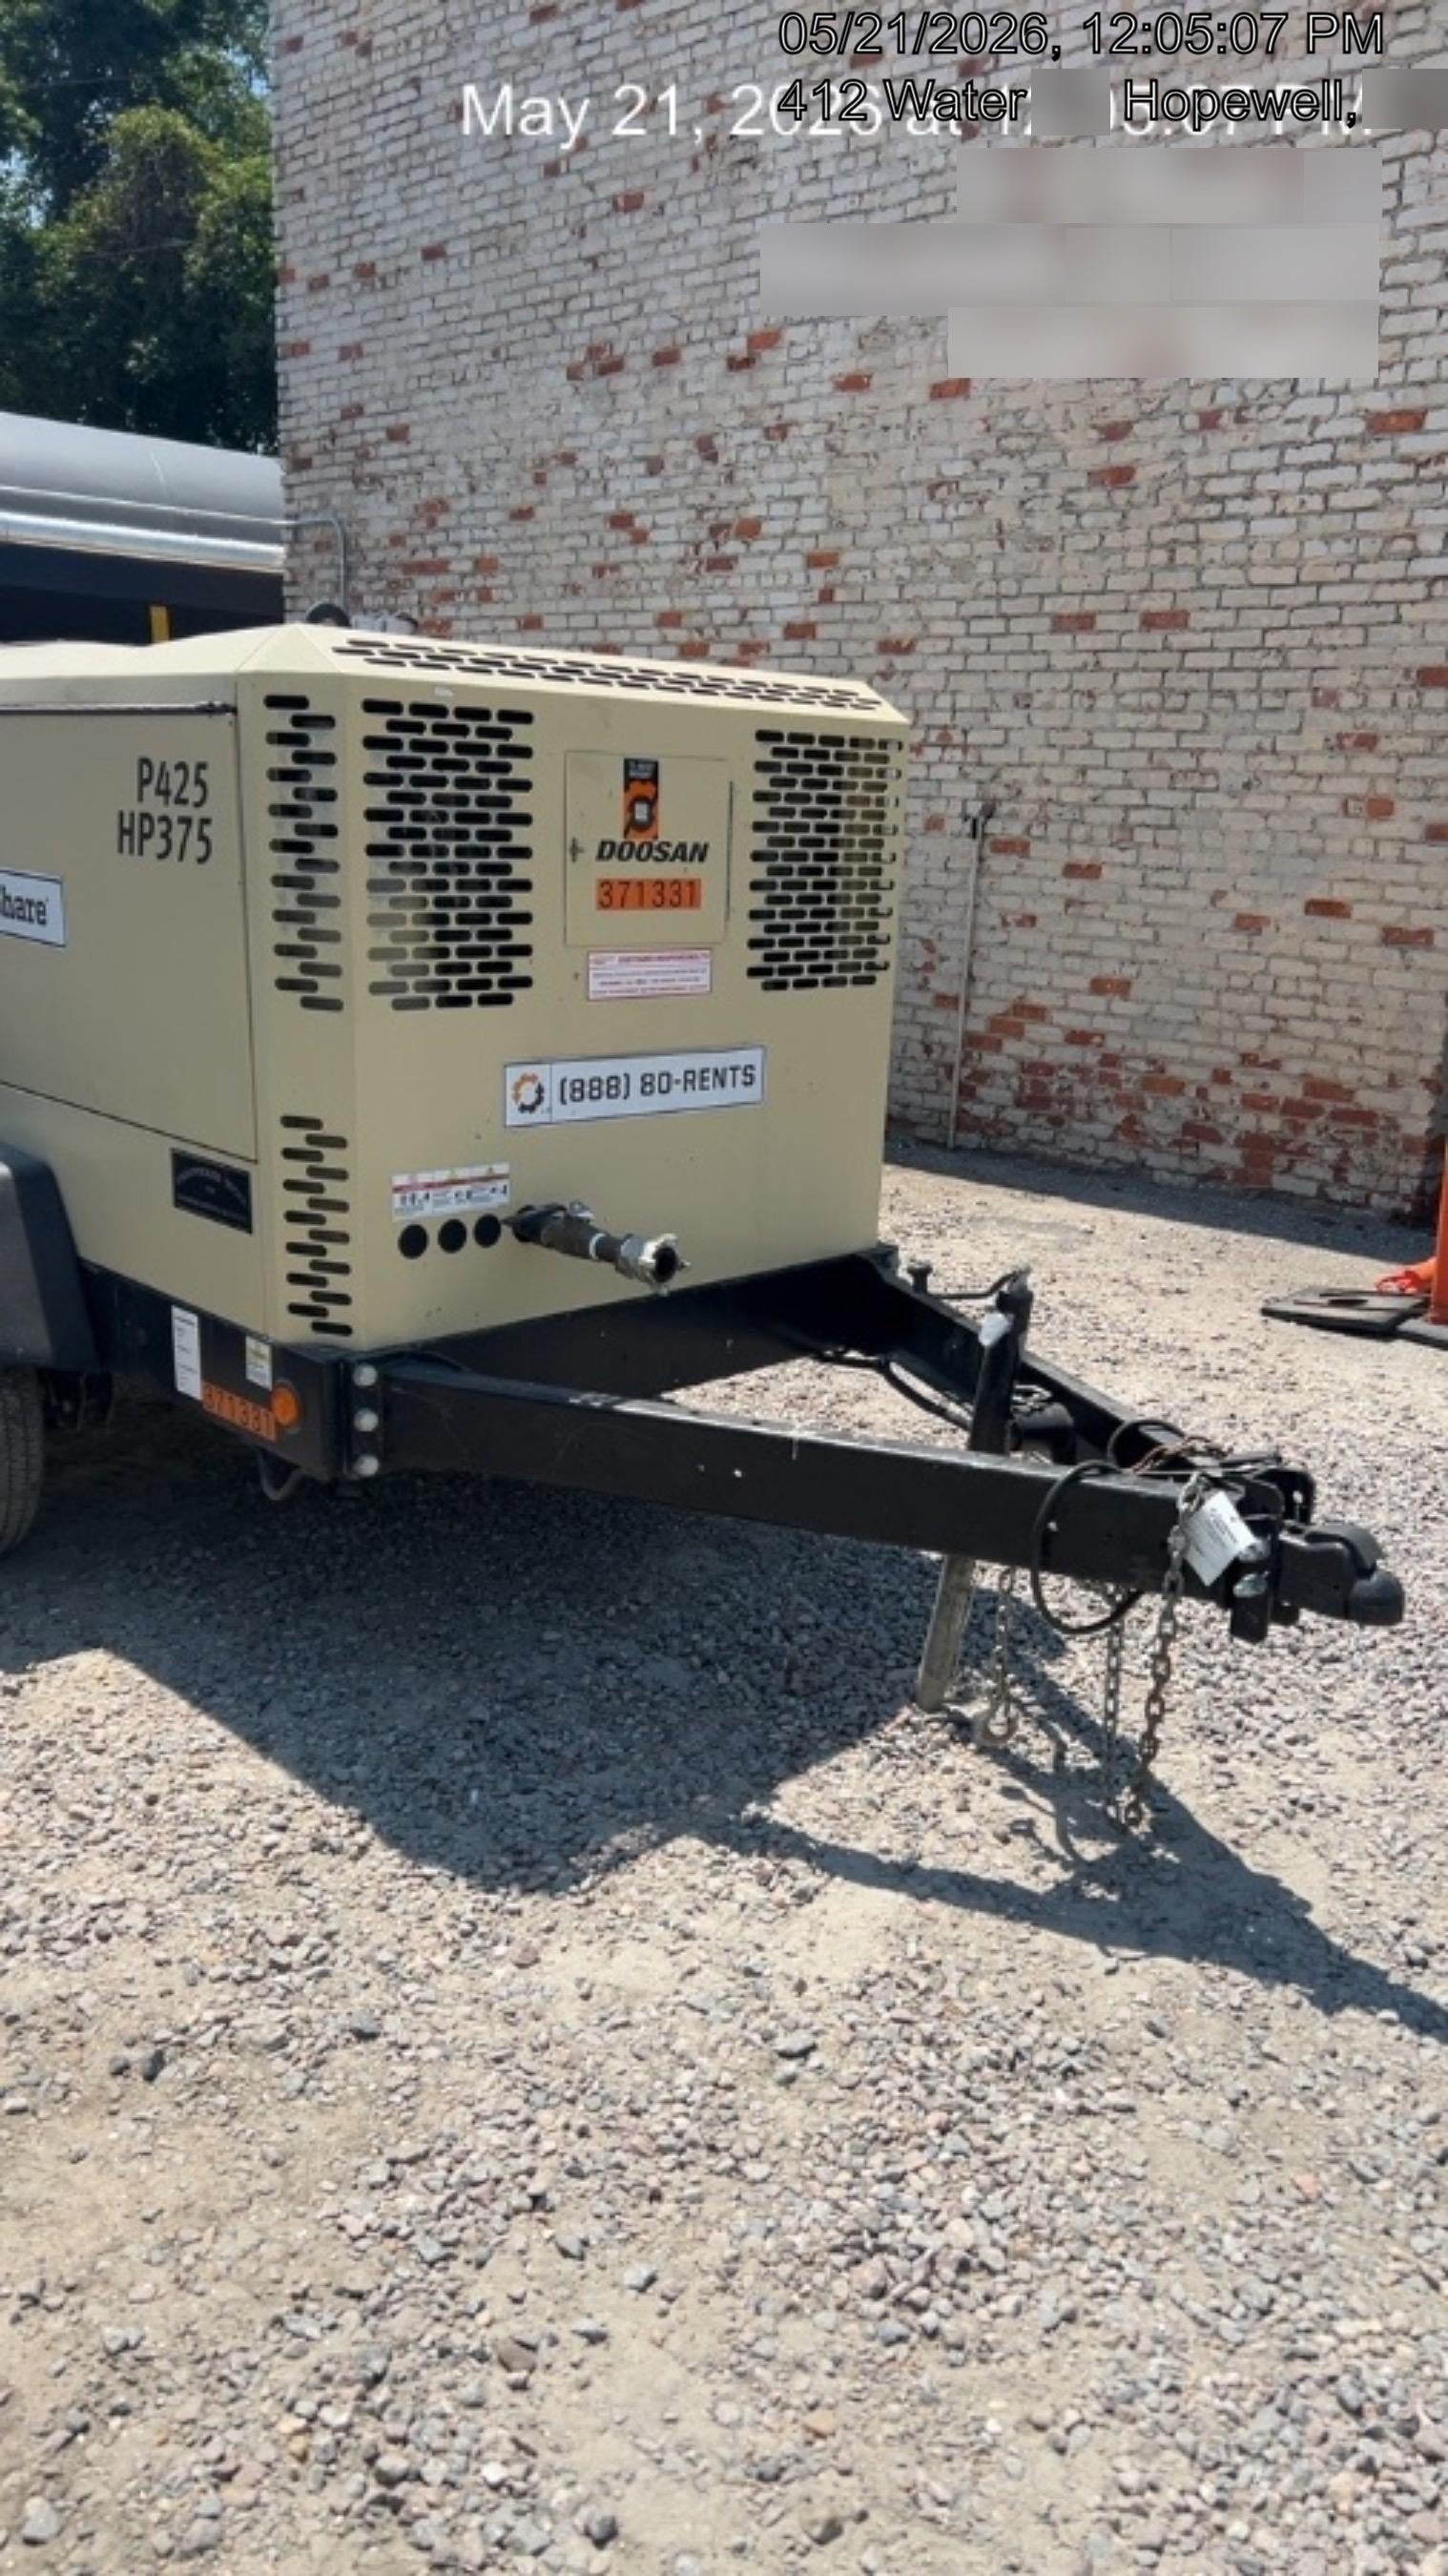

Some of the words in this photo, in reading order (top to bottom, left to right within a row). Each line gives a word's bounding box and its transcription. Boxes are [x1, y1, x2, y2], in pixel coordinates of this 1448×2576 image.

[136, 757, 209, 809] P425
[116, 809, 214, 865] HP375
[595, 839, 710, 863] DOOSAN
[0, 883, 48, 926] hare
[598, 879, 697, 908] 371331
[559, 1072, 631, 1106] (888)
[639, 1063, 757, 1096] 80-RENTS
